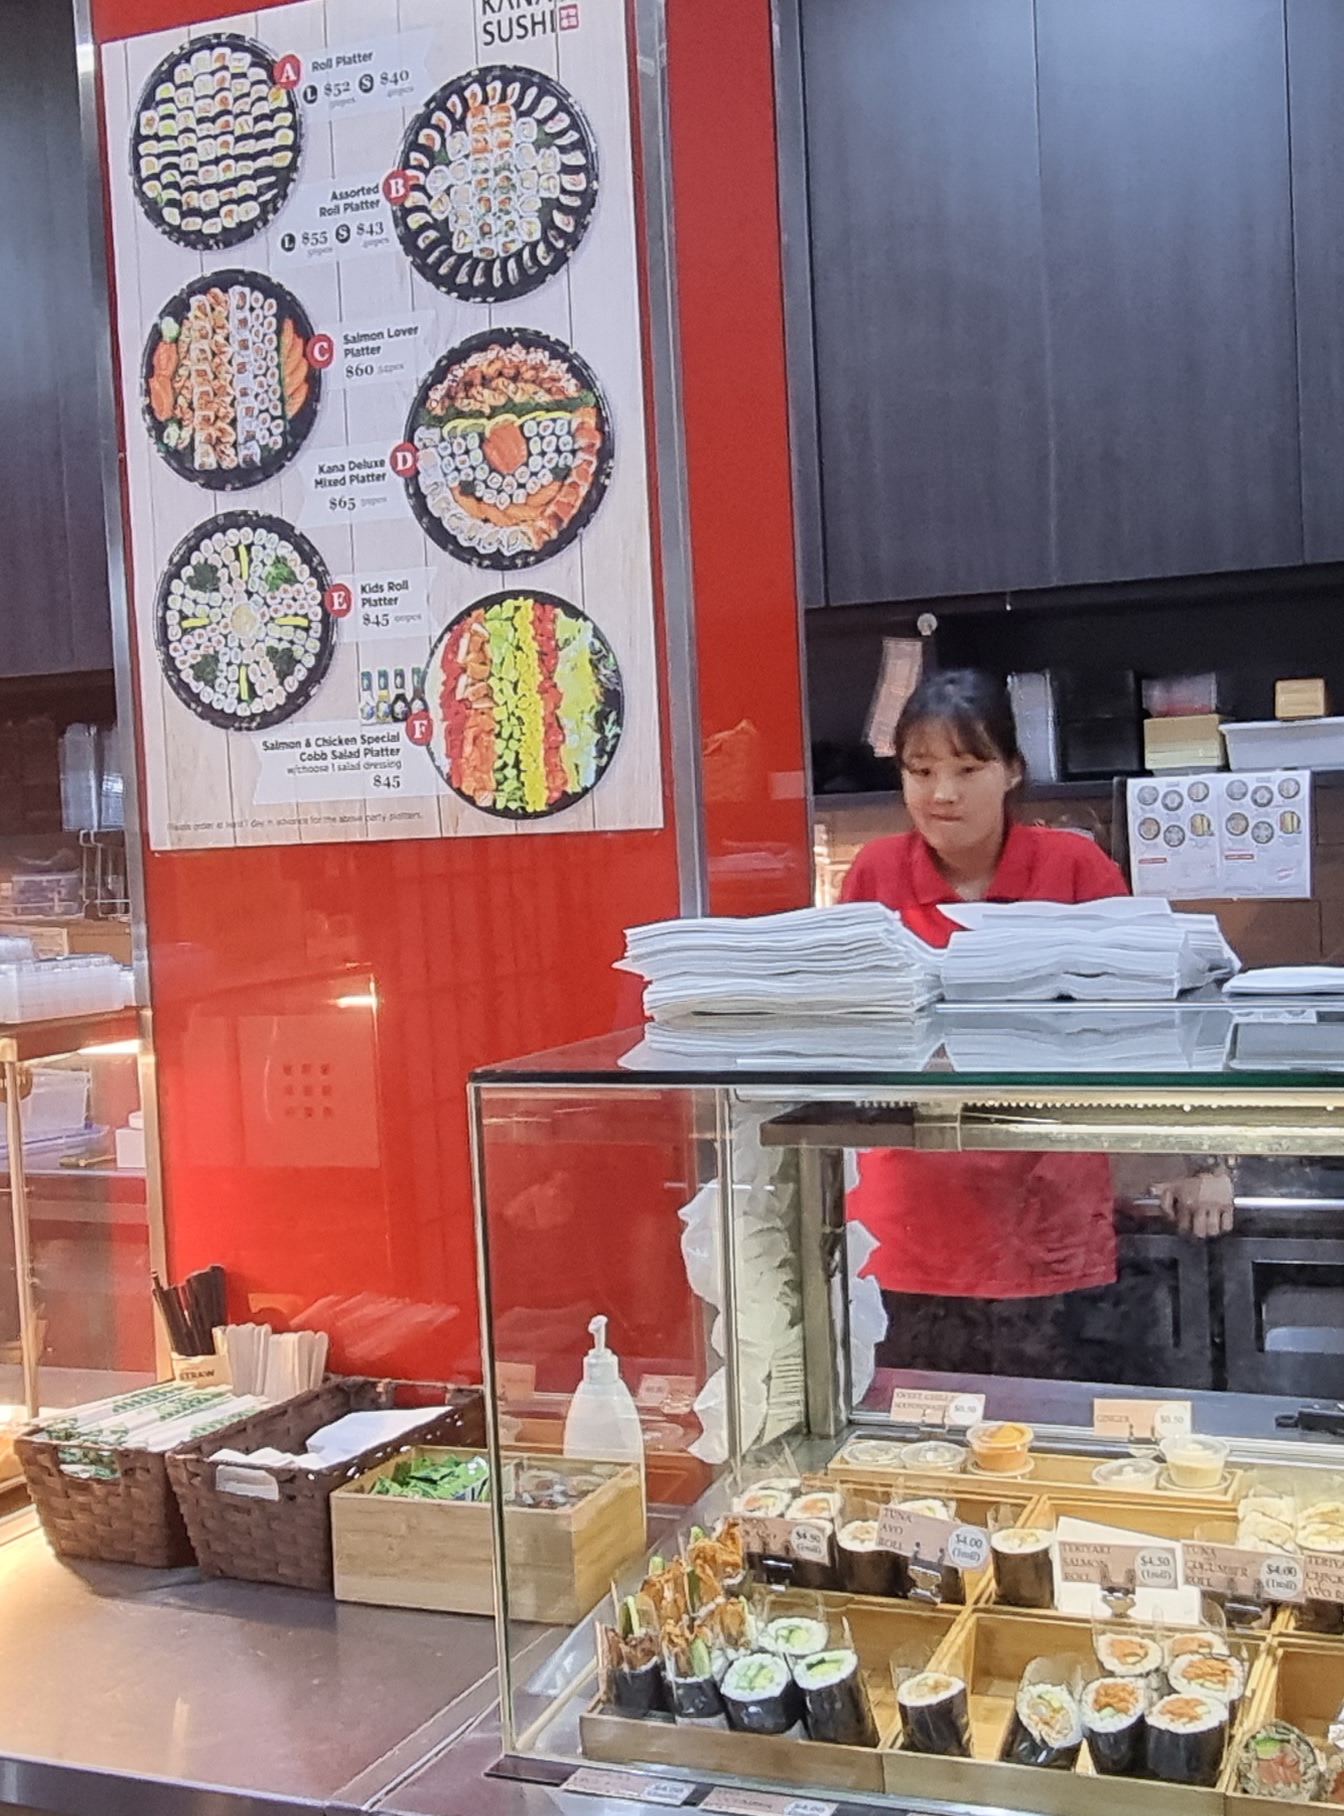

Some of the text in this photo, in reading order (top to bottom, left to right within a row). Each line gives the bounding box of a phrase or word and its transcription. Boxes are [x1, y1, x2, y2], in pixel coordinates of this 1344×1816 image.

[483, 9, 555, 46] SUSHI
[311, 51, 373, 72] Roll Platter
[324, 82, 350, 97] $52
[380, 70, 409, 85] $40
[331, 183, 380, 201] Assorted
[319, 199, 380, 218] Roll Platter
[301, 231, 328, 246] $55
[356, 221, 384, 236] $43
[343, 326, 418, 345] Salmon Lover
[344, 346, 381, 359] Platter
[345, 363, 374, 379] $60
[318, 458, 386, 475] Kana Deluxe
[314, 472, 387, 489] Mixed Platter
[328, 496, 356, 511] $65
[360, 580, 409, 594] Kids Roll
[361, 597, 399, 608] Platter
[362, 613, 390, 627] $45
[262, 732, 400, 751] Salmon & Chicken Special
[299, 747, 401, 762] Cobb Salad Platter
[363, 759, 402, 771] dressing
[373, 775, 401, 788] $45
